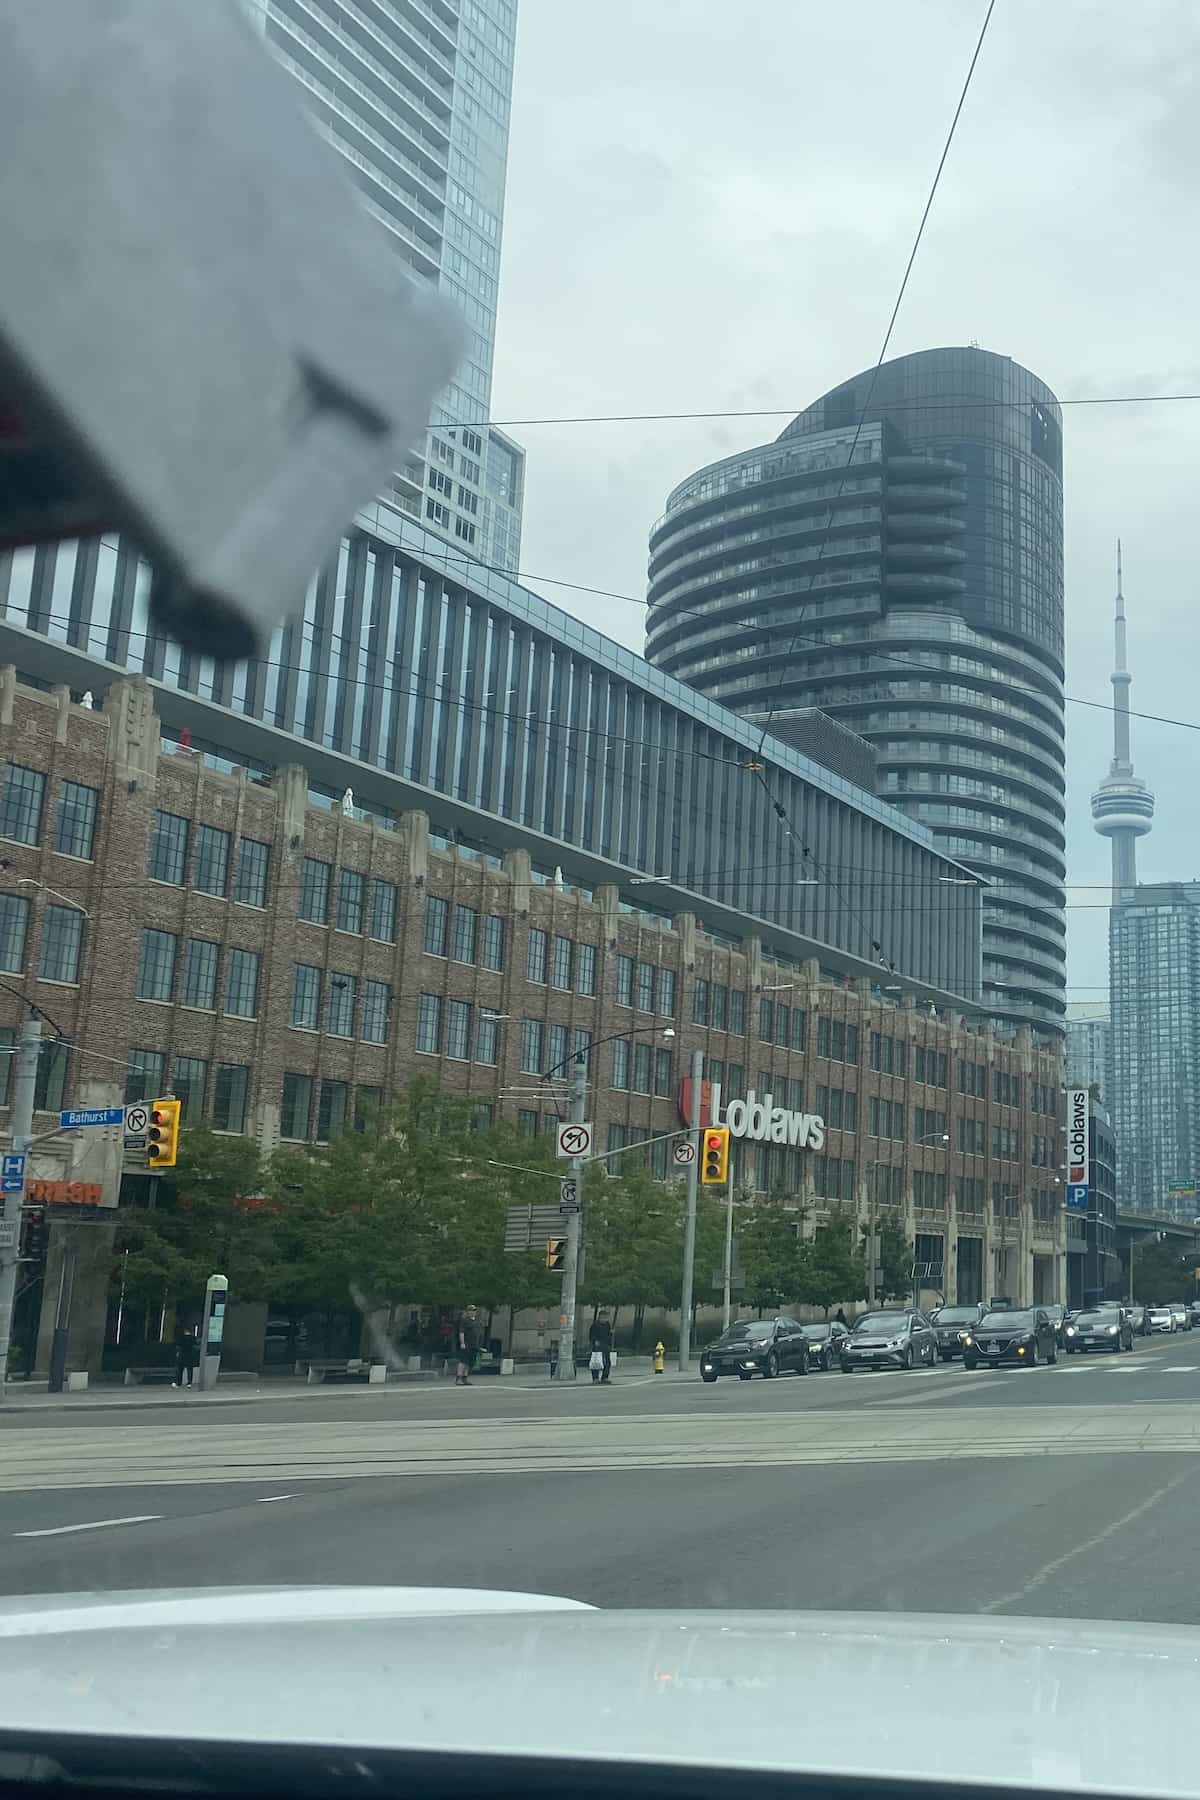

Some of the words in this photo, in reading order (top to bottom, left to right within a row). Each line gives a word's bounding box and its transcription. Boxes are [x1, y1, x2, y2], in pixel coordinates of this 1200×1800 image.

[68, 1111, 108, 1124] Bathurst
[712, 1083, 825, 1150] Loblaws
[1070, 1092, 1085, 1166] Loblaws
[5, 1158, 23, 1175] H
[1074, 1188, 1086, 1202] P
